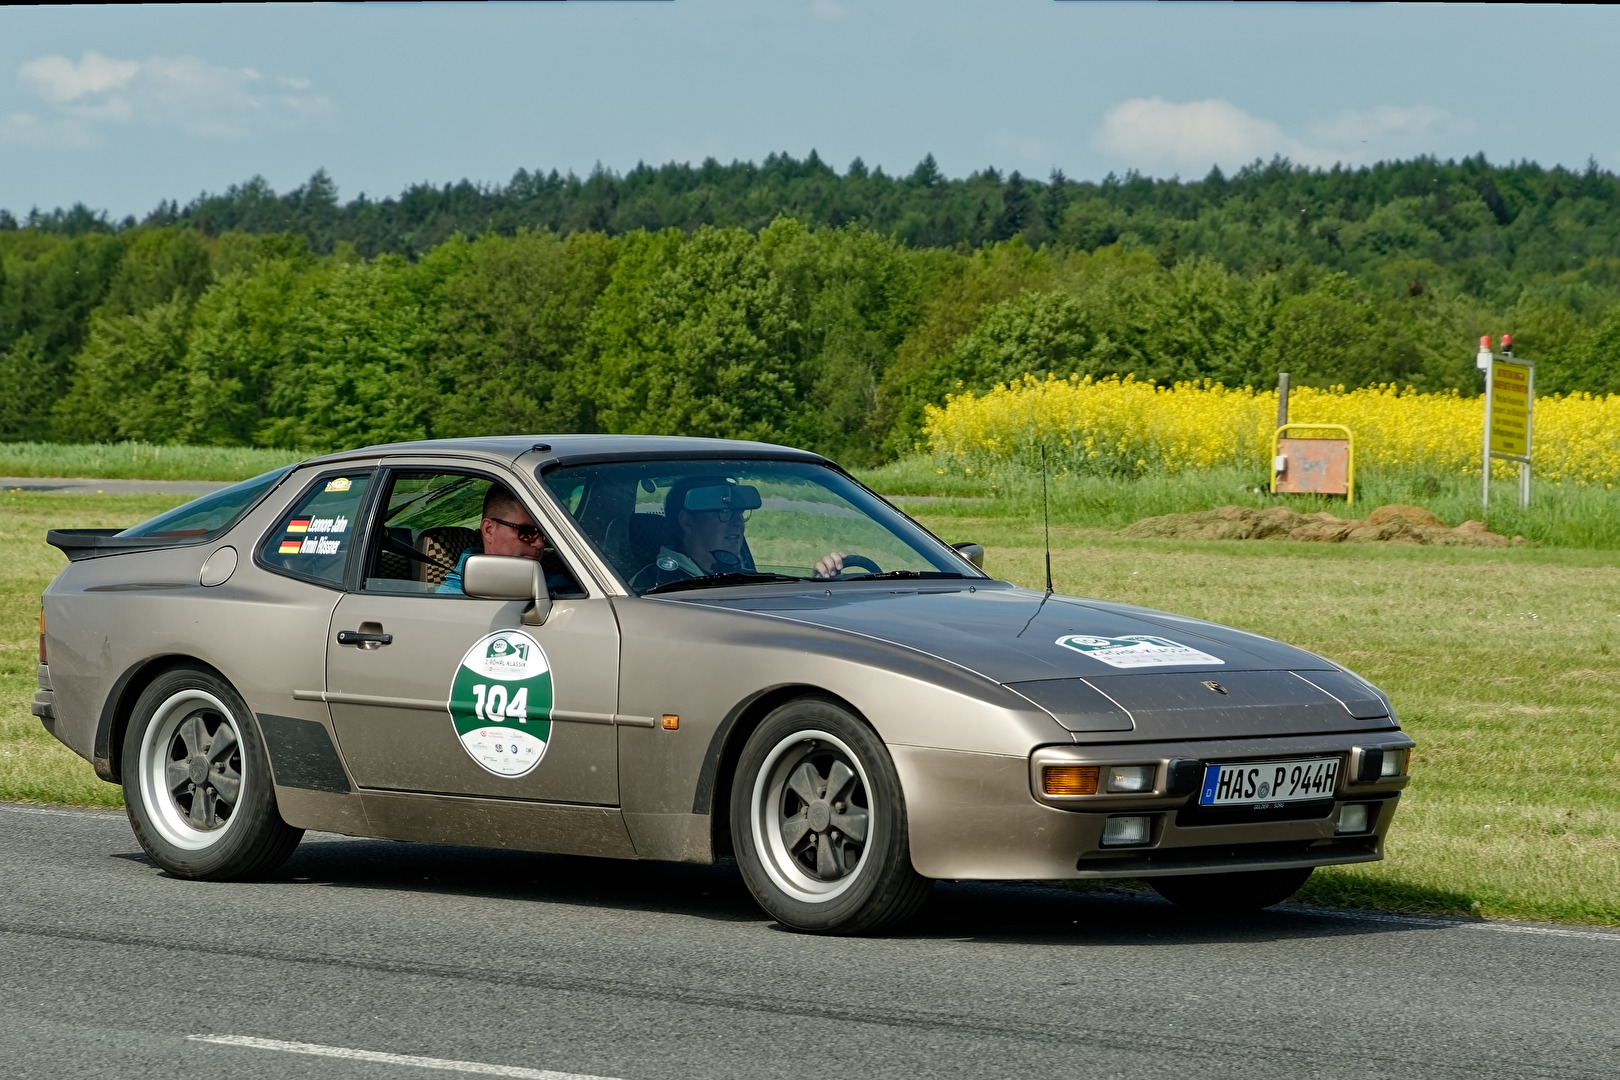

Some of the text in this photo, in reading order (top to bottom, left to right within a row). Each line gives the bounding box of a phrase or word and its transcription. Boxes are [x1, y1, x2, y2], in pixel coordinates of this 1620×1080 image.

[473, 684, 528, 723] 104
[1217, 762, 1338, 800] HAS P 944H
